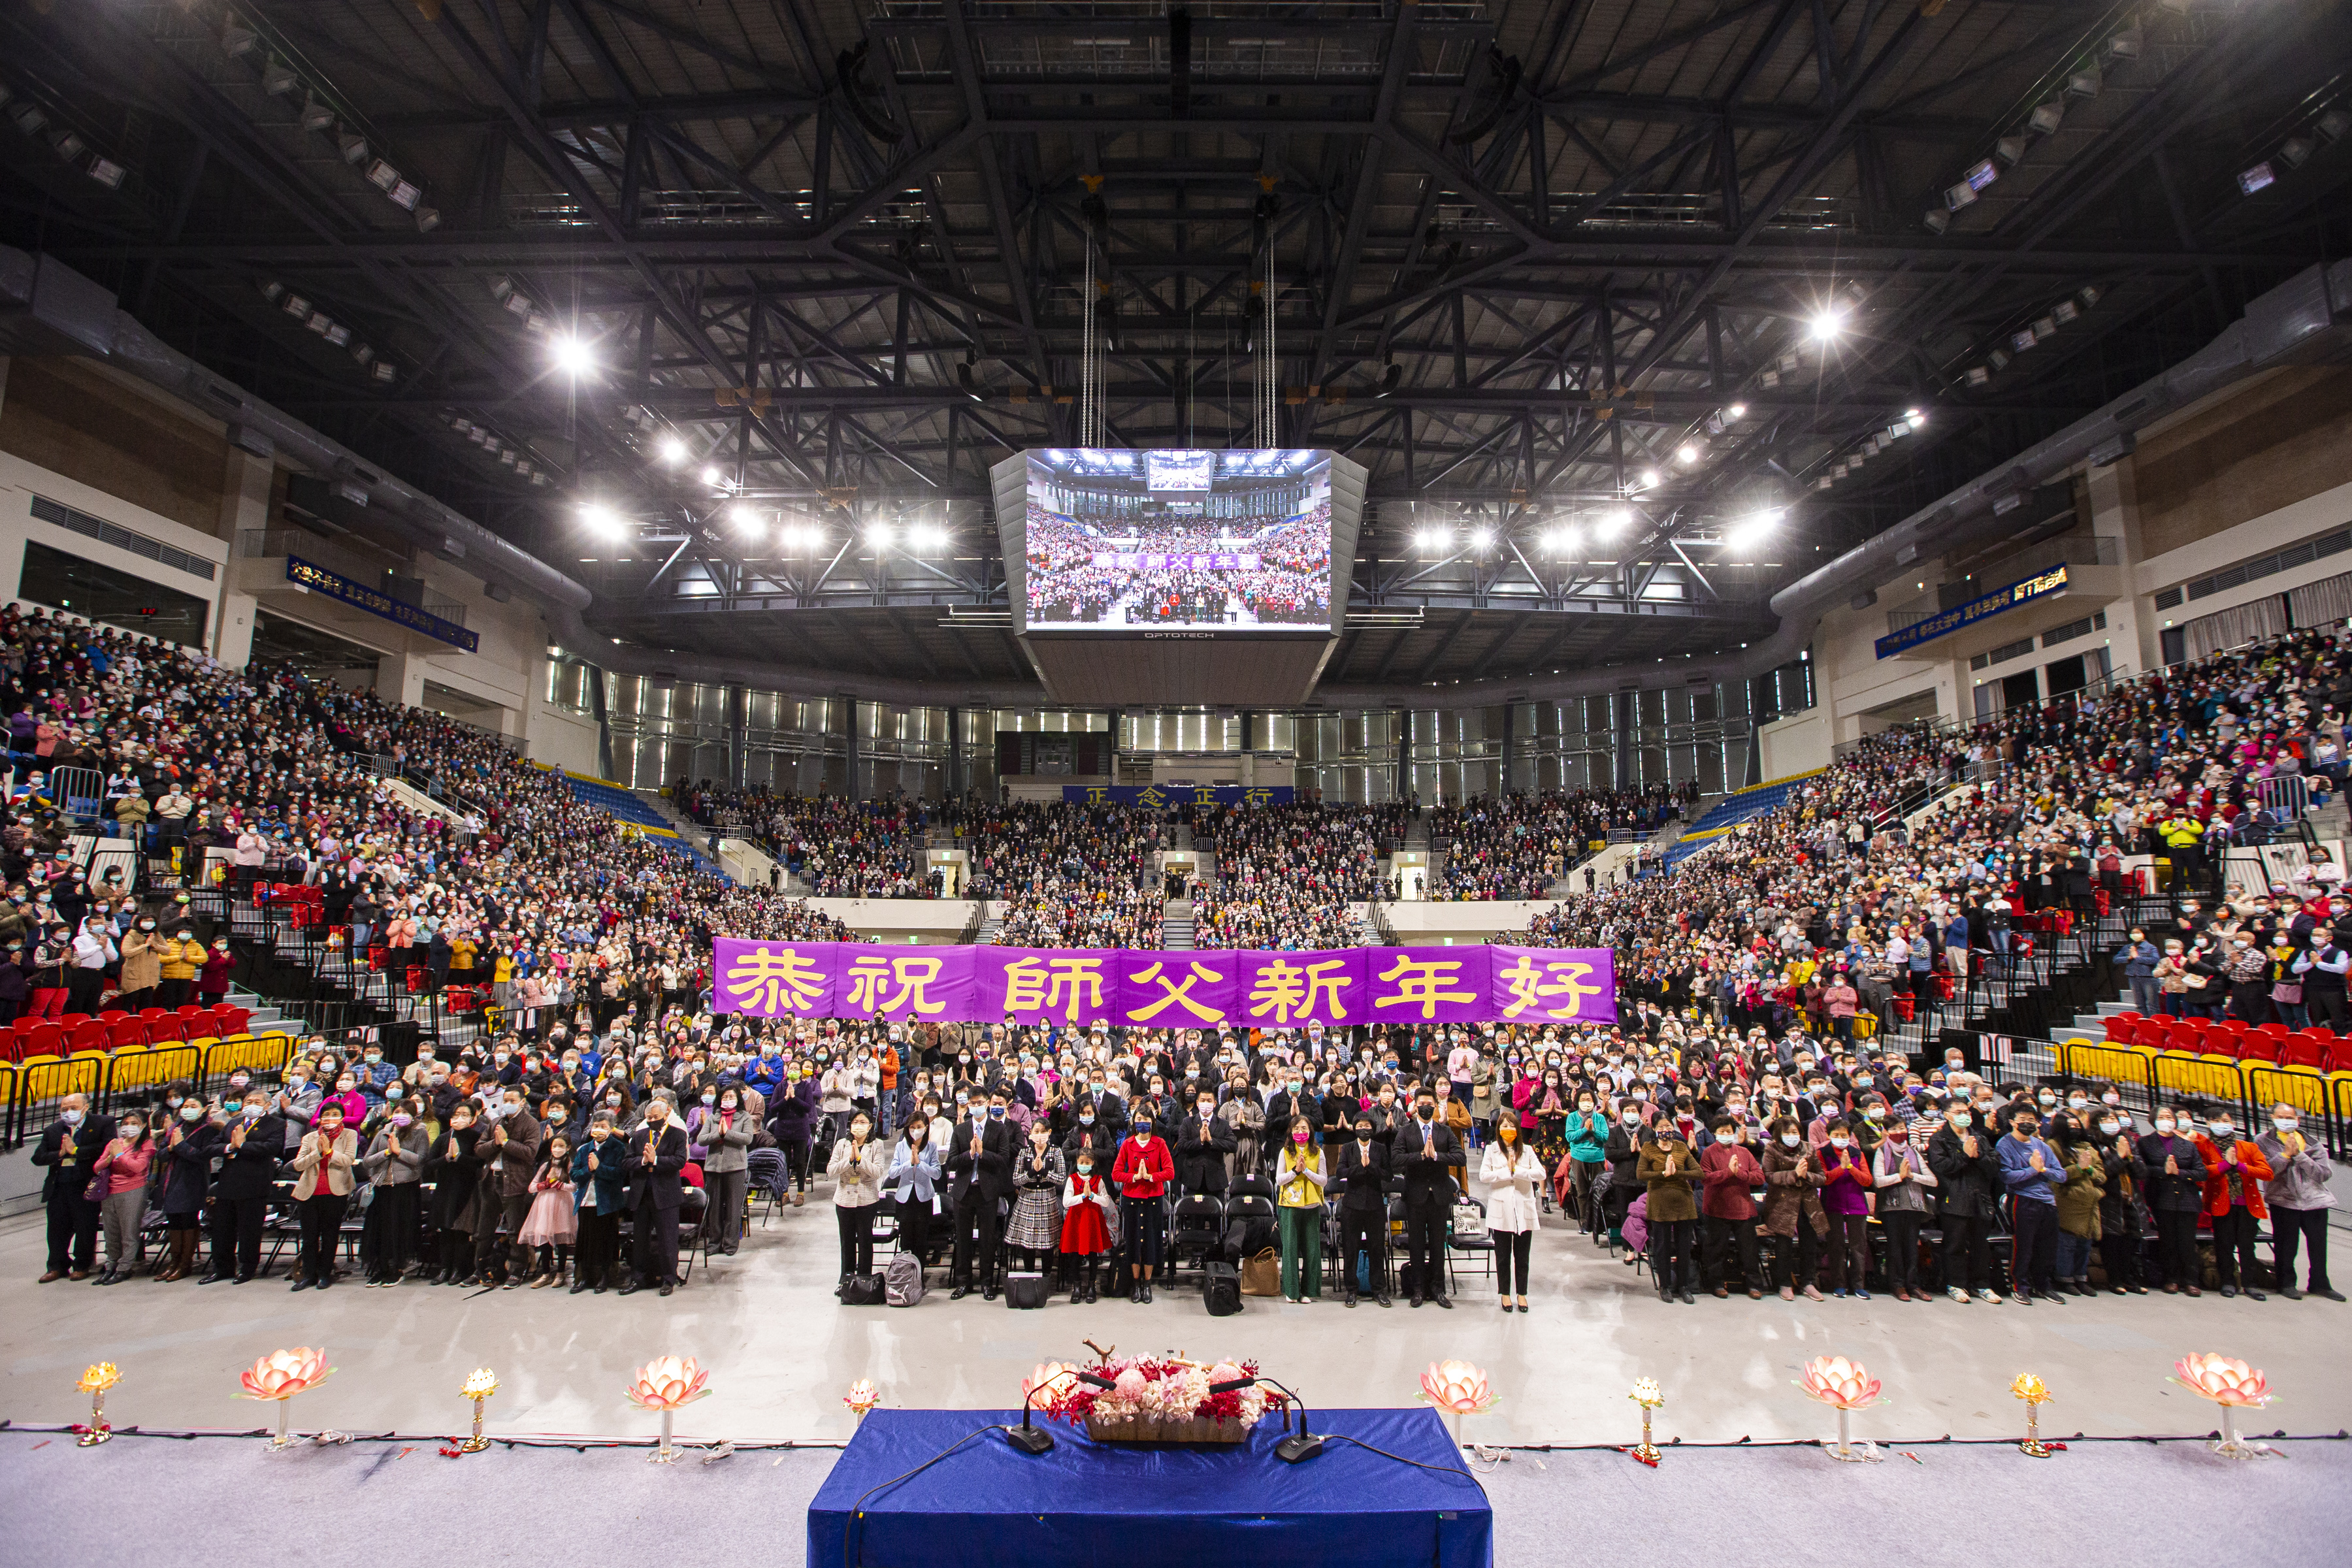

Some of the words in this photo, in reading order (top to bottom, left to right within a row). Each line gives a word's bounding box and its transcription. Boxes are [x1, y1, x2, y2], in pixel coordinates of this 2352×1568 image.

[1085, 786, 1274, 808] 正念正行
[727, 947, 947, 1015] 恭祝
[1003, 954, 1602, 1024] 師父新年好
